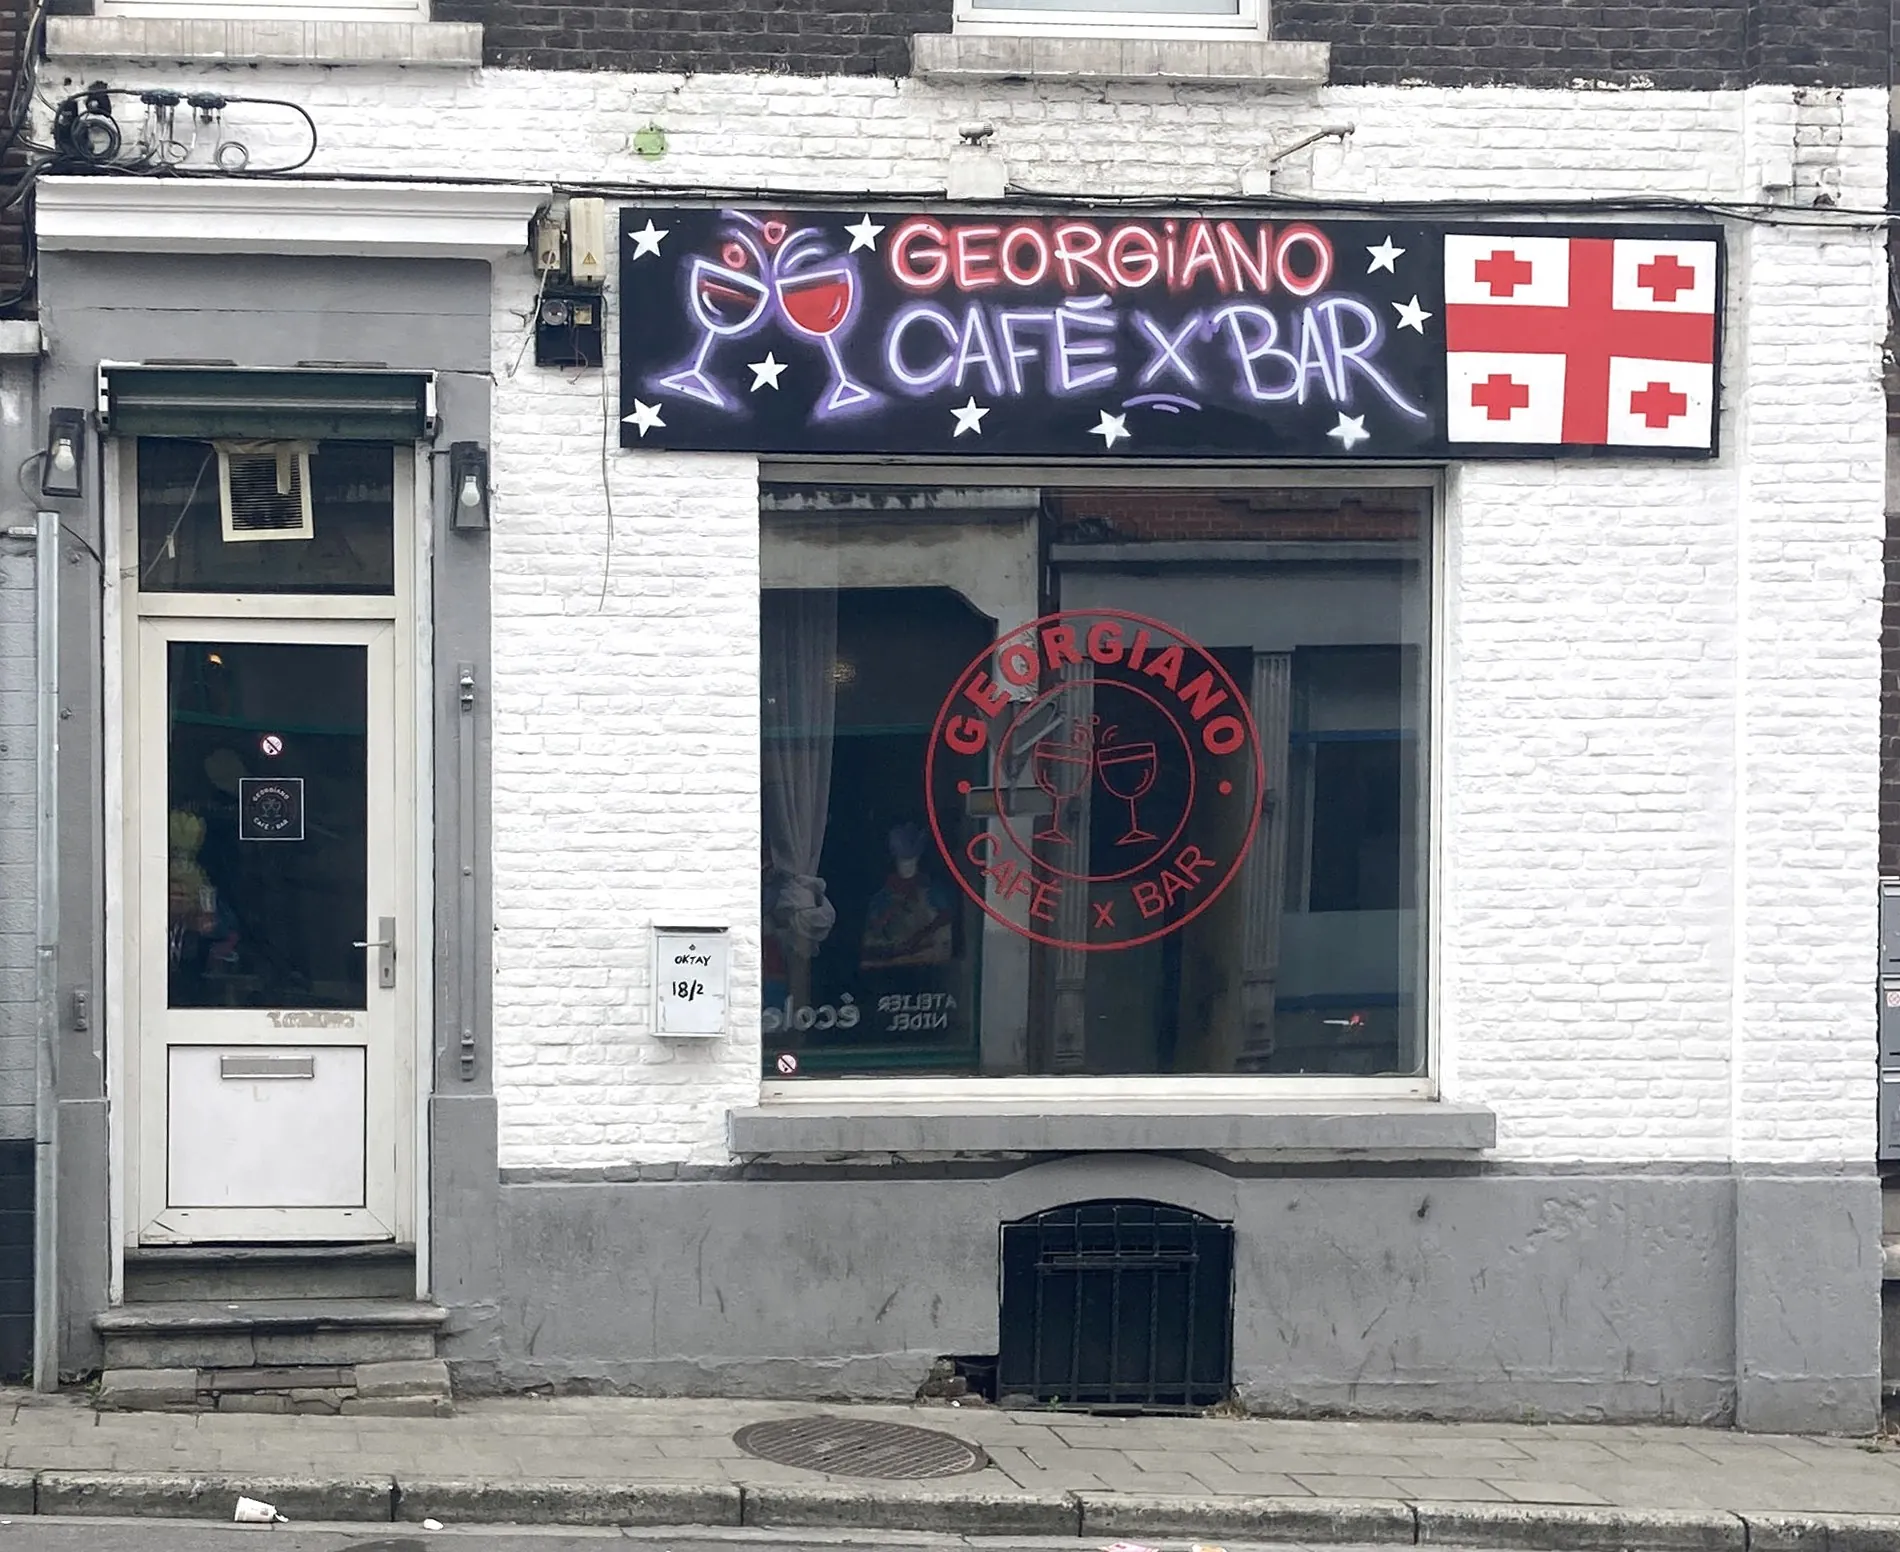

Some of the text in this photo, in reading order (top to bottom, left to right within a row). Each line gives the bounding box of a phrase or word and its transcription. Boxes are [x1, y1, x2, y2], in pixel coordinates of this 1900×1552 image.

[1211, 299, 1427, 418] BAR
[945, 620, 1246, 756] GEORGIANO
[966, 831, 1063, 922] CAFÉ
[1131, 843, 1217, 919] BAR
[672, 979, 705, 1002] 18/2
[674, 954, 712, 967] OKTAY
